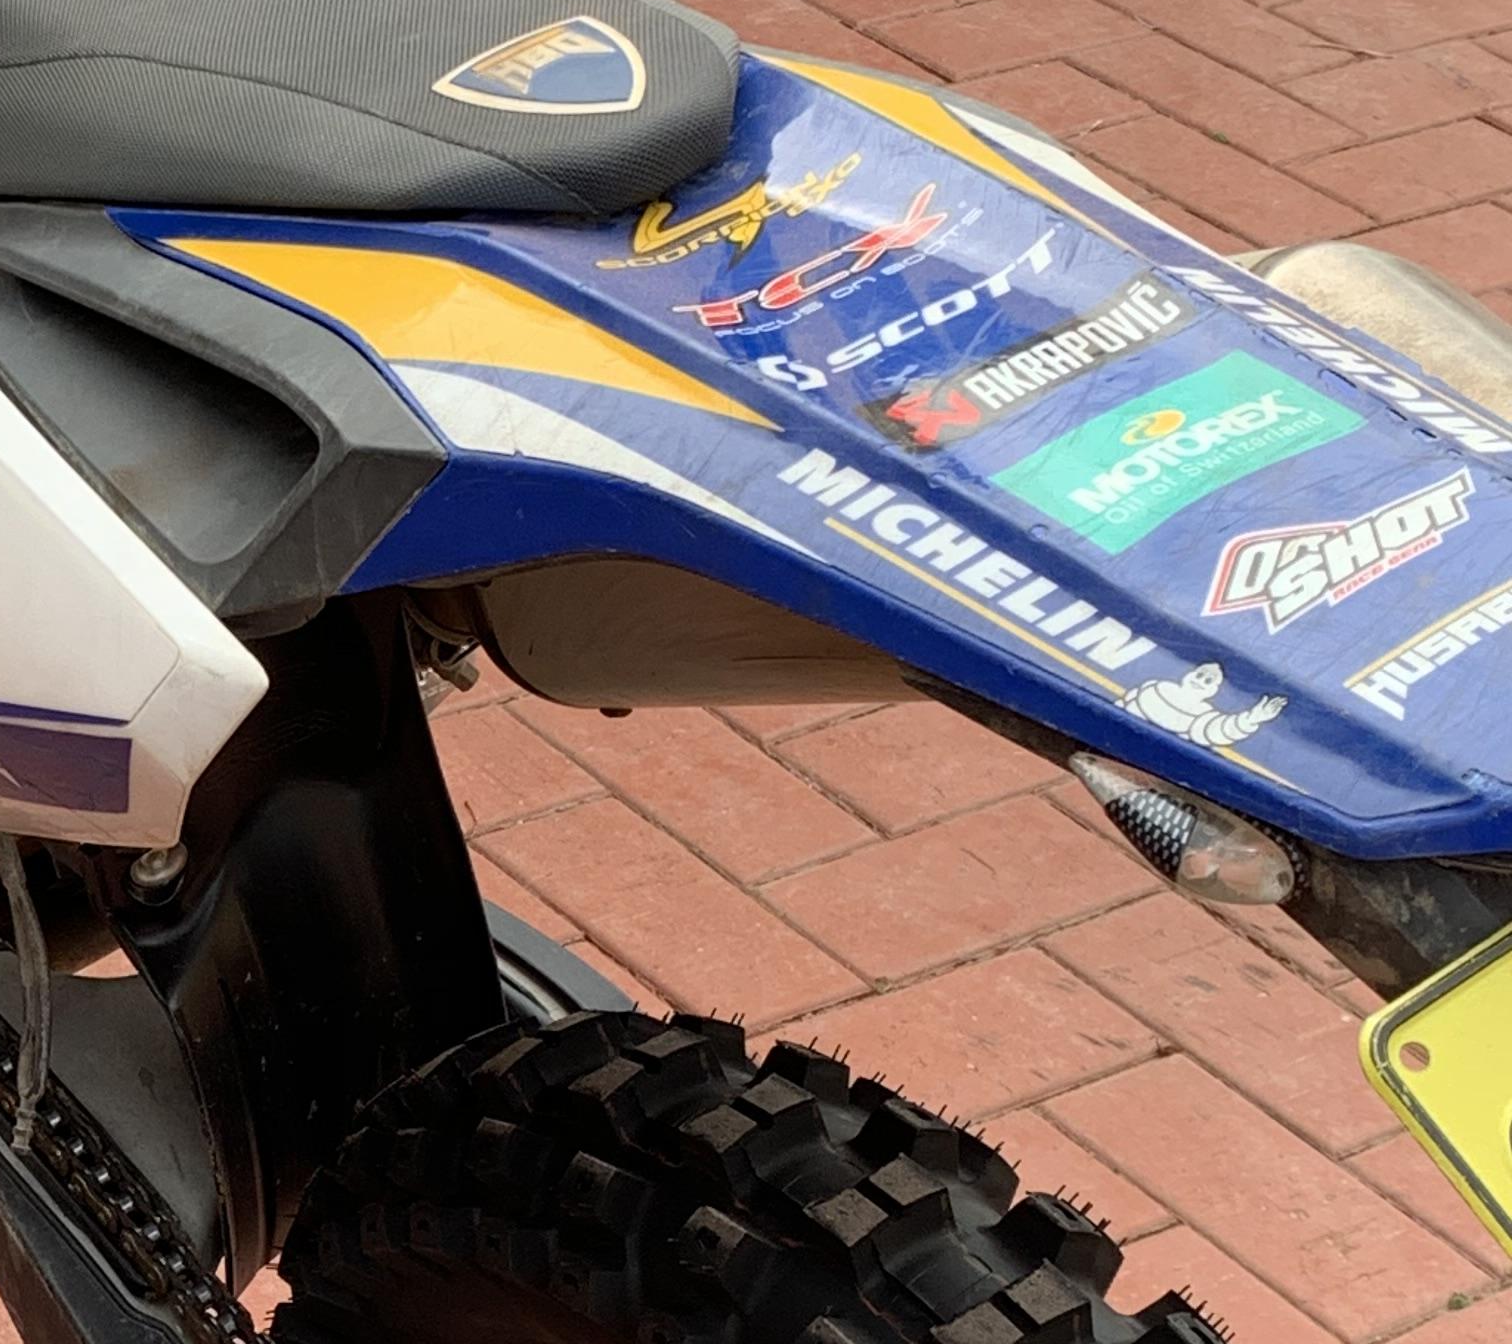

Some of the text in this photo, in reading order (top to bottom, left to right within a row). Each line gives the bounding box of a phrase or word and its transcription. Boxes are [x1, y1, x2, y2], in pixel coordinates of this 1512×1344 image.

[594, 170, 817, 271] SCORPION
[672, 183, 949, 327] TCX
[714, 299, 825, 338] FOCUS
[826, 228, 1060, 374] SCOTT
[1161, 264, 1512, 453] MICHELIN
[1066, 389, 1303, 514] MOTOREX
[1104, 411, 1326, 525] Oil of Switzerland
[776, 447, 1158, 671] MICHELIN
[1267, 476, 1466, 624] SHOT
[1349, 590, 1512, 722] HUSAB
